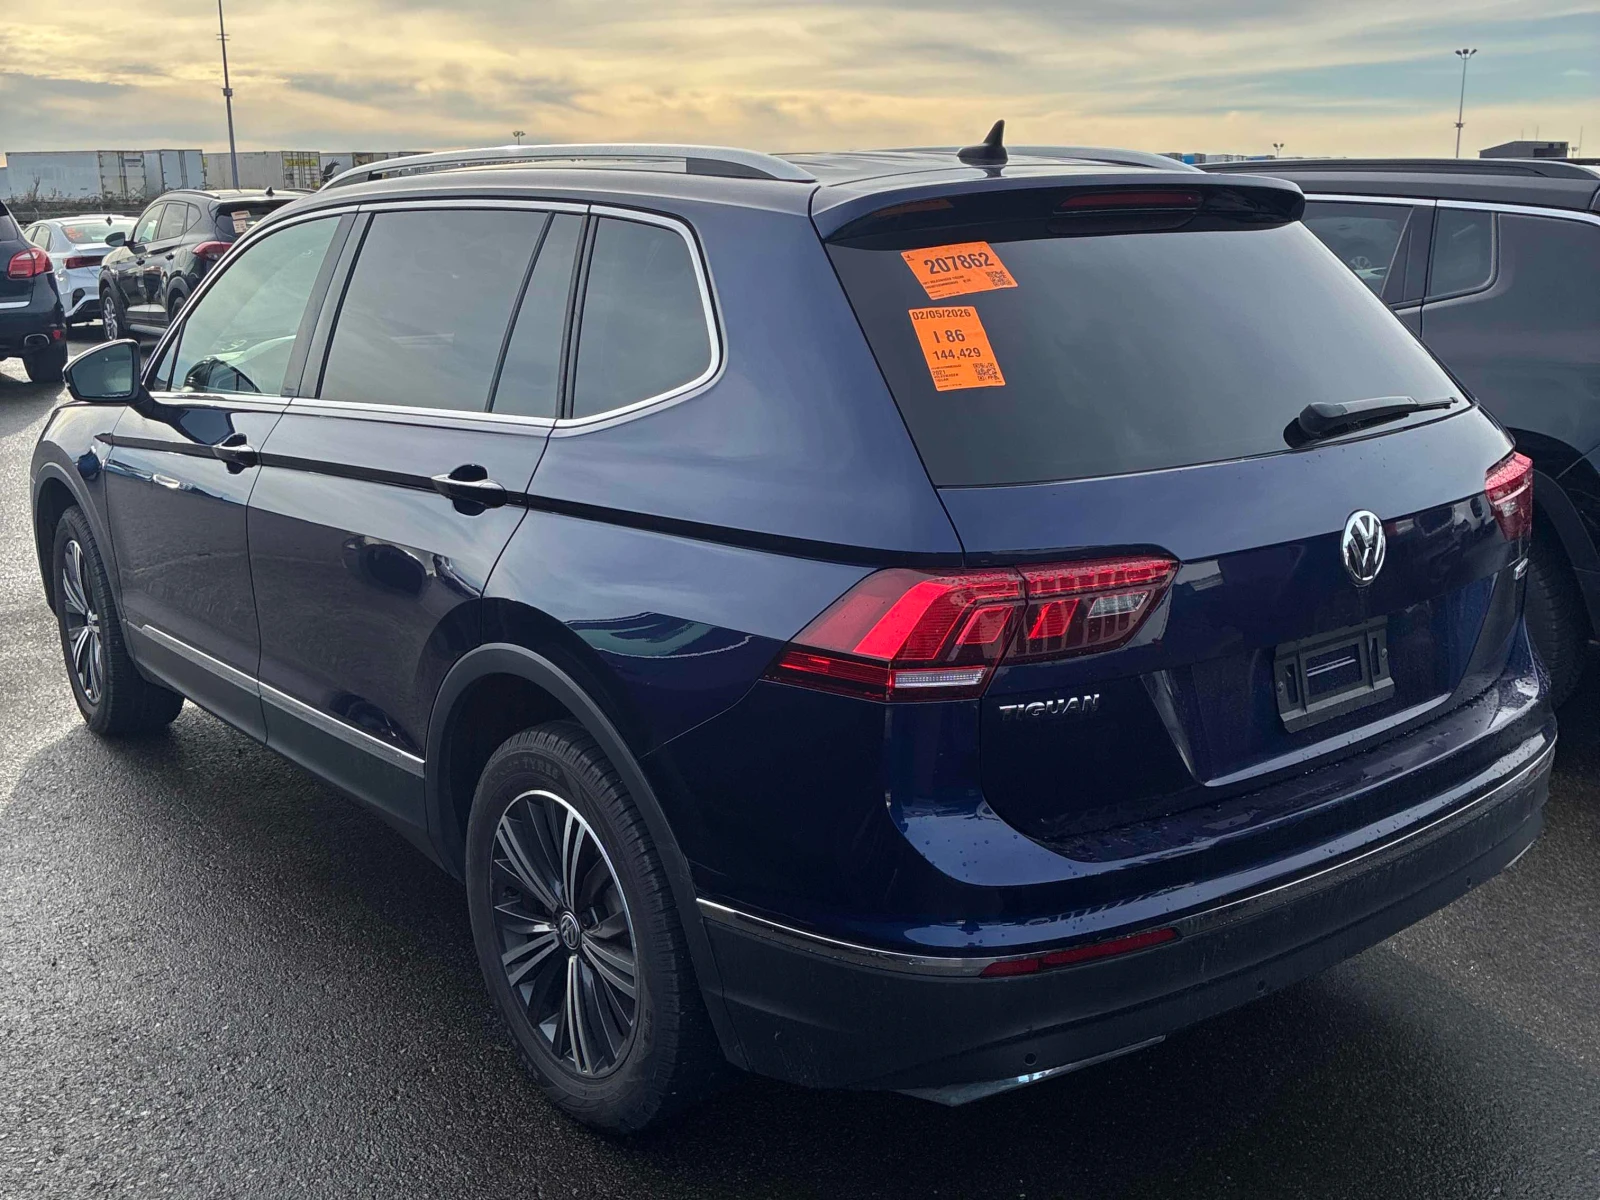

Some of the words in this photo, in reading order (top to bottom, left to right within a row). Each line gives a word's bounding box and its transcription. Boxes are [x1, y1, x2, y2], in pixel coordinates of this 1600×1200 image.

[924, 252, 994, 274] 207862
[912, 308, 972, 321] 02/05/2026
[945, 329, 966, 343] 86
[932, 347, 981, 361] 144,429
[999, 693, 1102, 722] TIGUAN
